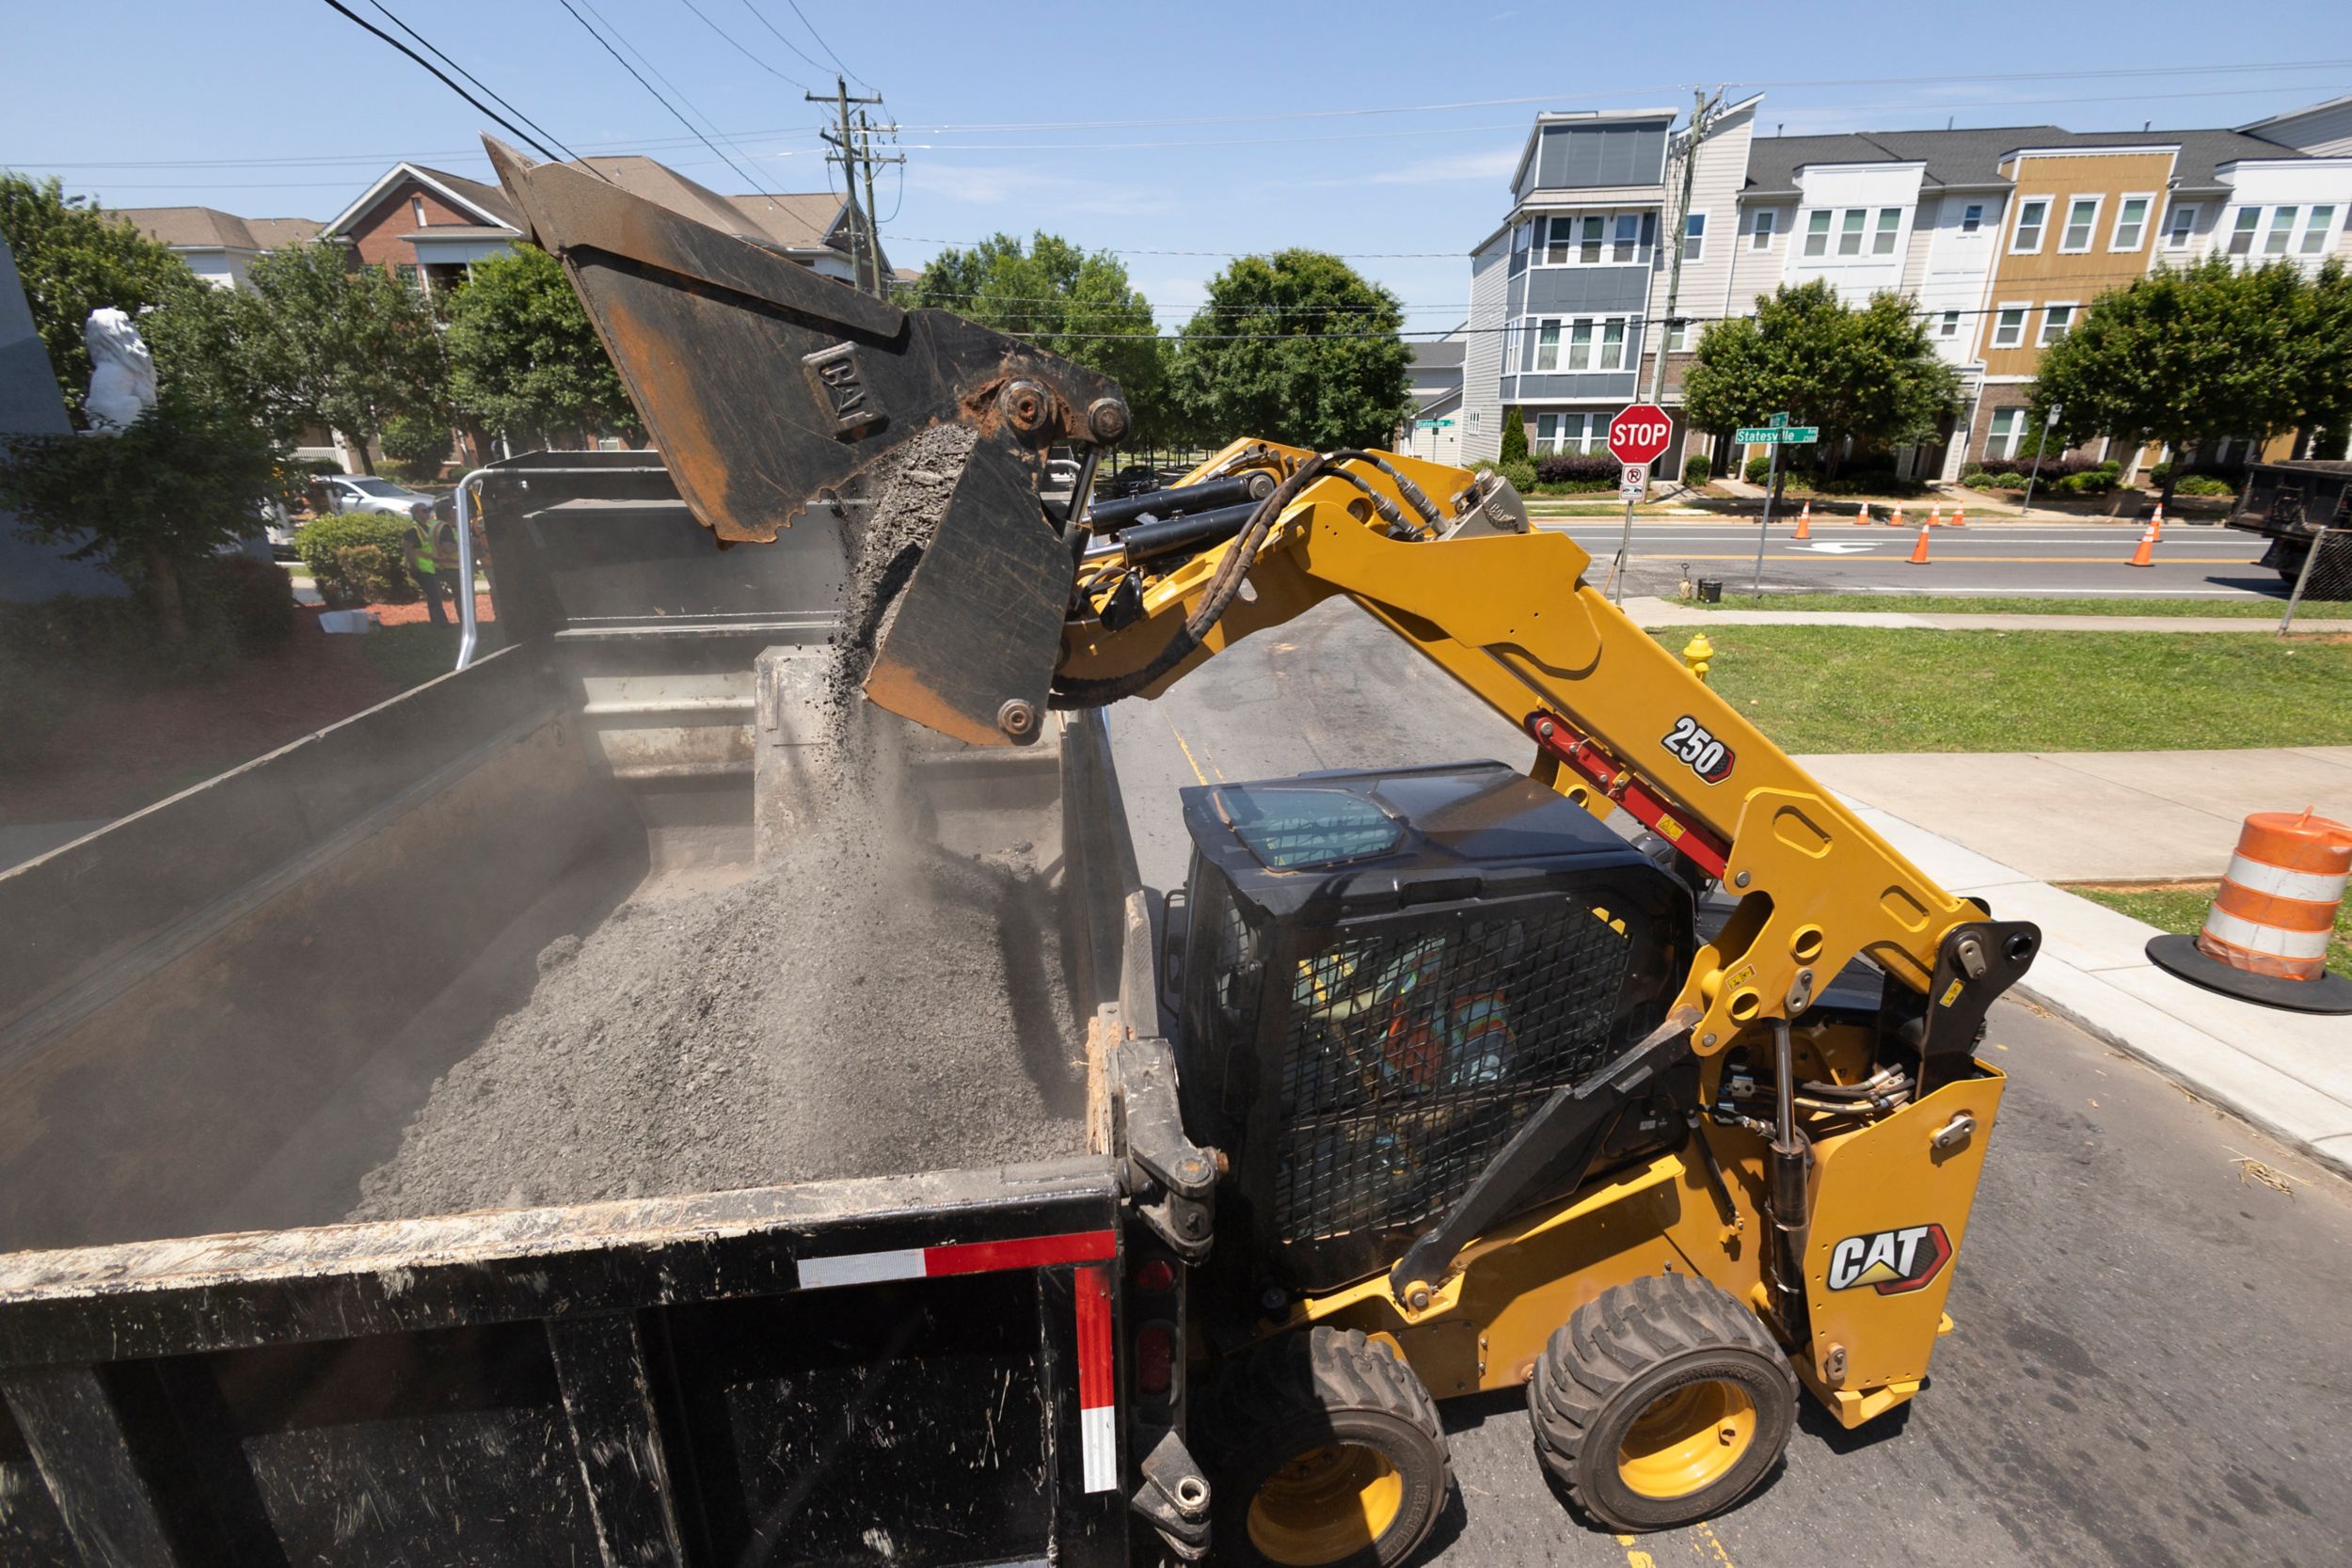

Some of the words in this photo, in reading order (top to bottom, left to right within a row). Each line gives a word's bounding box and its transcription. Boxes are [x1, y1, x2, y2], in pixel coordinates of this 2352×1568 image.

[818, 358, 873, 421] CAT
[1613, 423, 1667, 447] STOP
[1738, 430, 1795, 442] Statesville
[1662, 717, 1724, 774] 250
[1828, 1226, 1929, 1290] CAT
